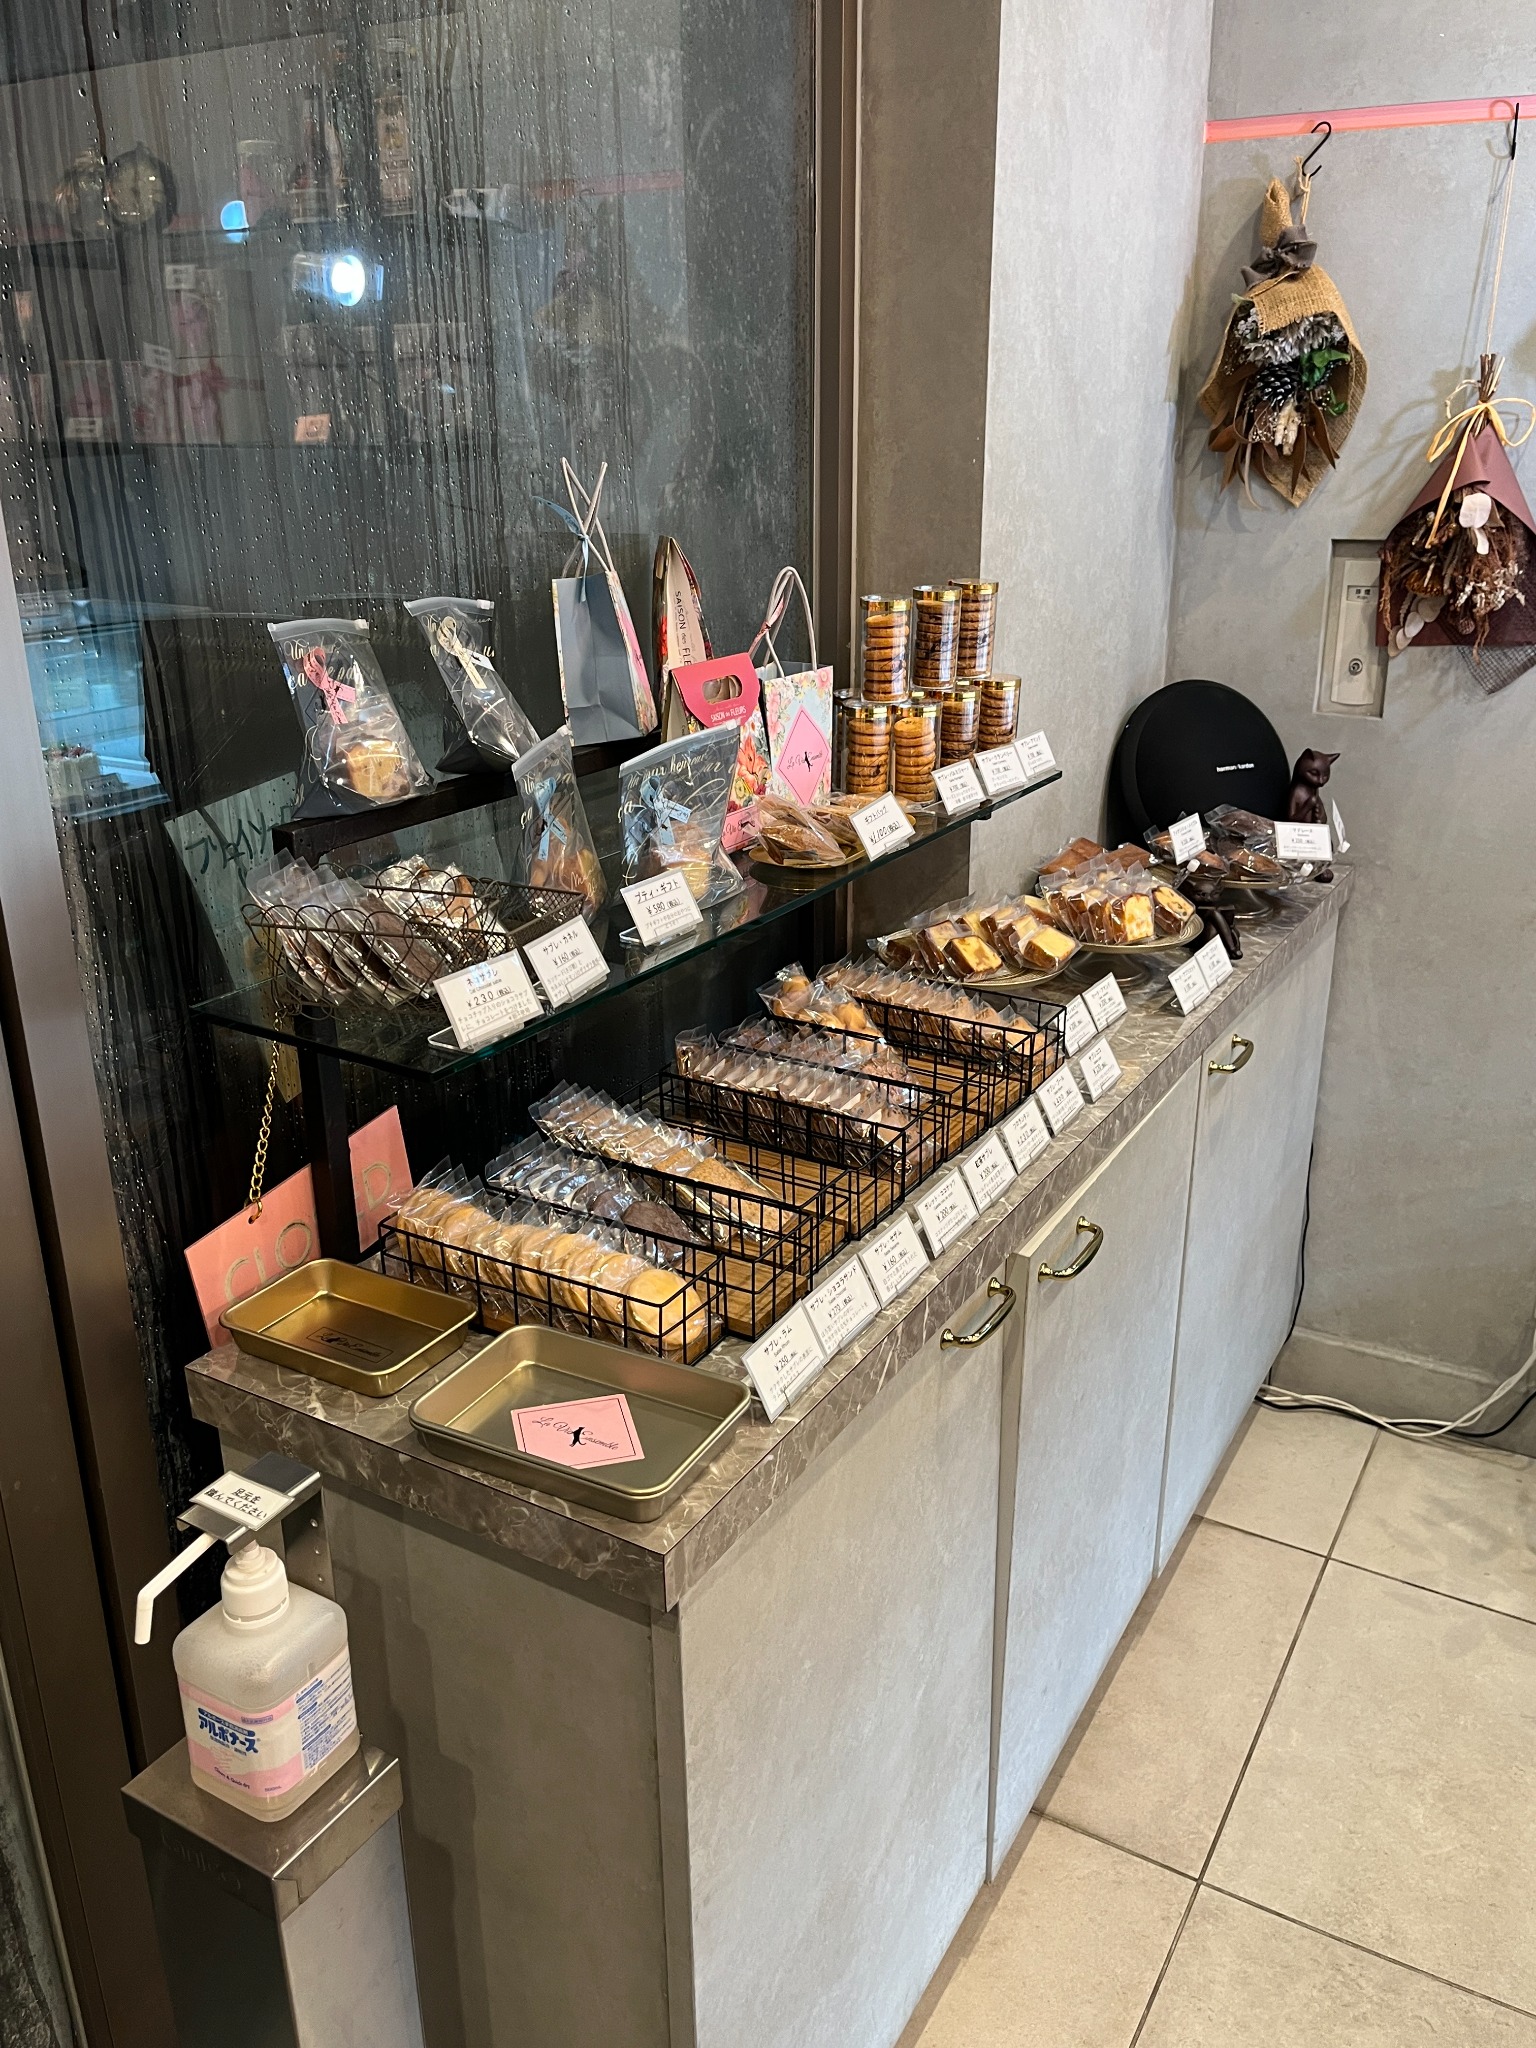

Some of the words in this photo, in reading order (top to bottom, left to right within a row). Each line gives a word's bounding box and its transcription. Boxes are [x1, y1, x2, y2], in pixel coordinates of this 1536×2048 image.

[674, 590, 686, 630] SAISON
[681, 647, 692, 666] FLE
[710, 711, 726, 722] SAISON
[729, 705, 747, 717] FLEURS
[645, 900, 665, 915] ¥580
[542, 930, 578, 954] サブレ・カネル
[551, 951, 569, 966] ¥160
[466, 990, 494, 1007] ¥230
[974, 1148, 992, 1168] 紅茶サブレ
[881, 1254, 897, 1271] ¥160
[809, 1264, 856, 1310] サブレ・ショコラサンド
[763, 1325, 792, 1355] サブレ・ラム
[773, 1354, 789, 1372] ¥250
[532, 1416, 554, 1428] La
[203, 1487, 268, 1519] 踏んでください
[231, 1487, 262, 1504] 足元を
[198, 1715, 259, 1753] アルボナース
